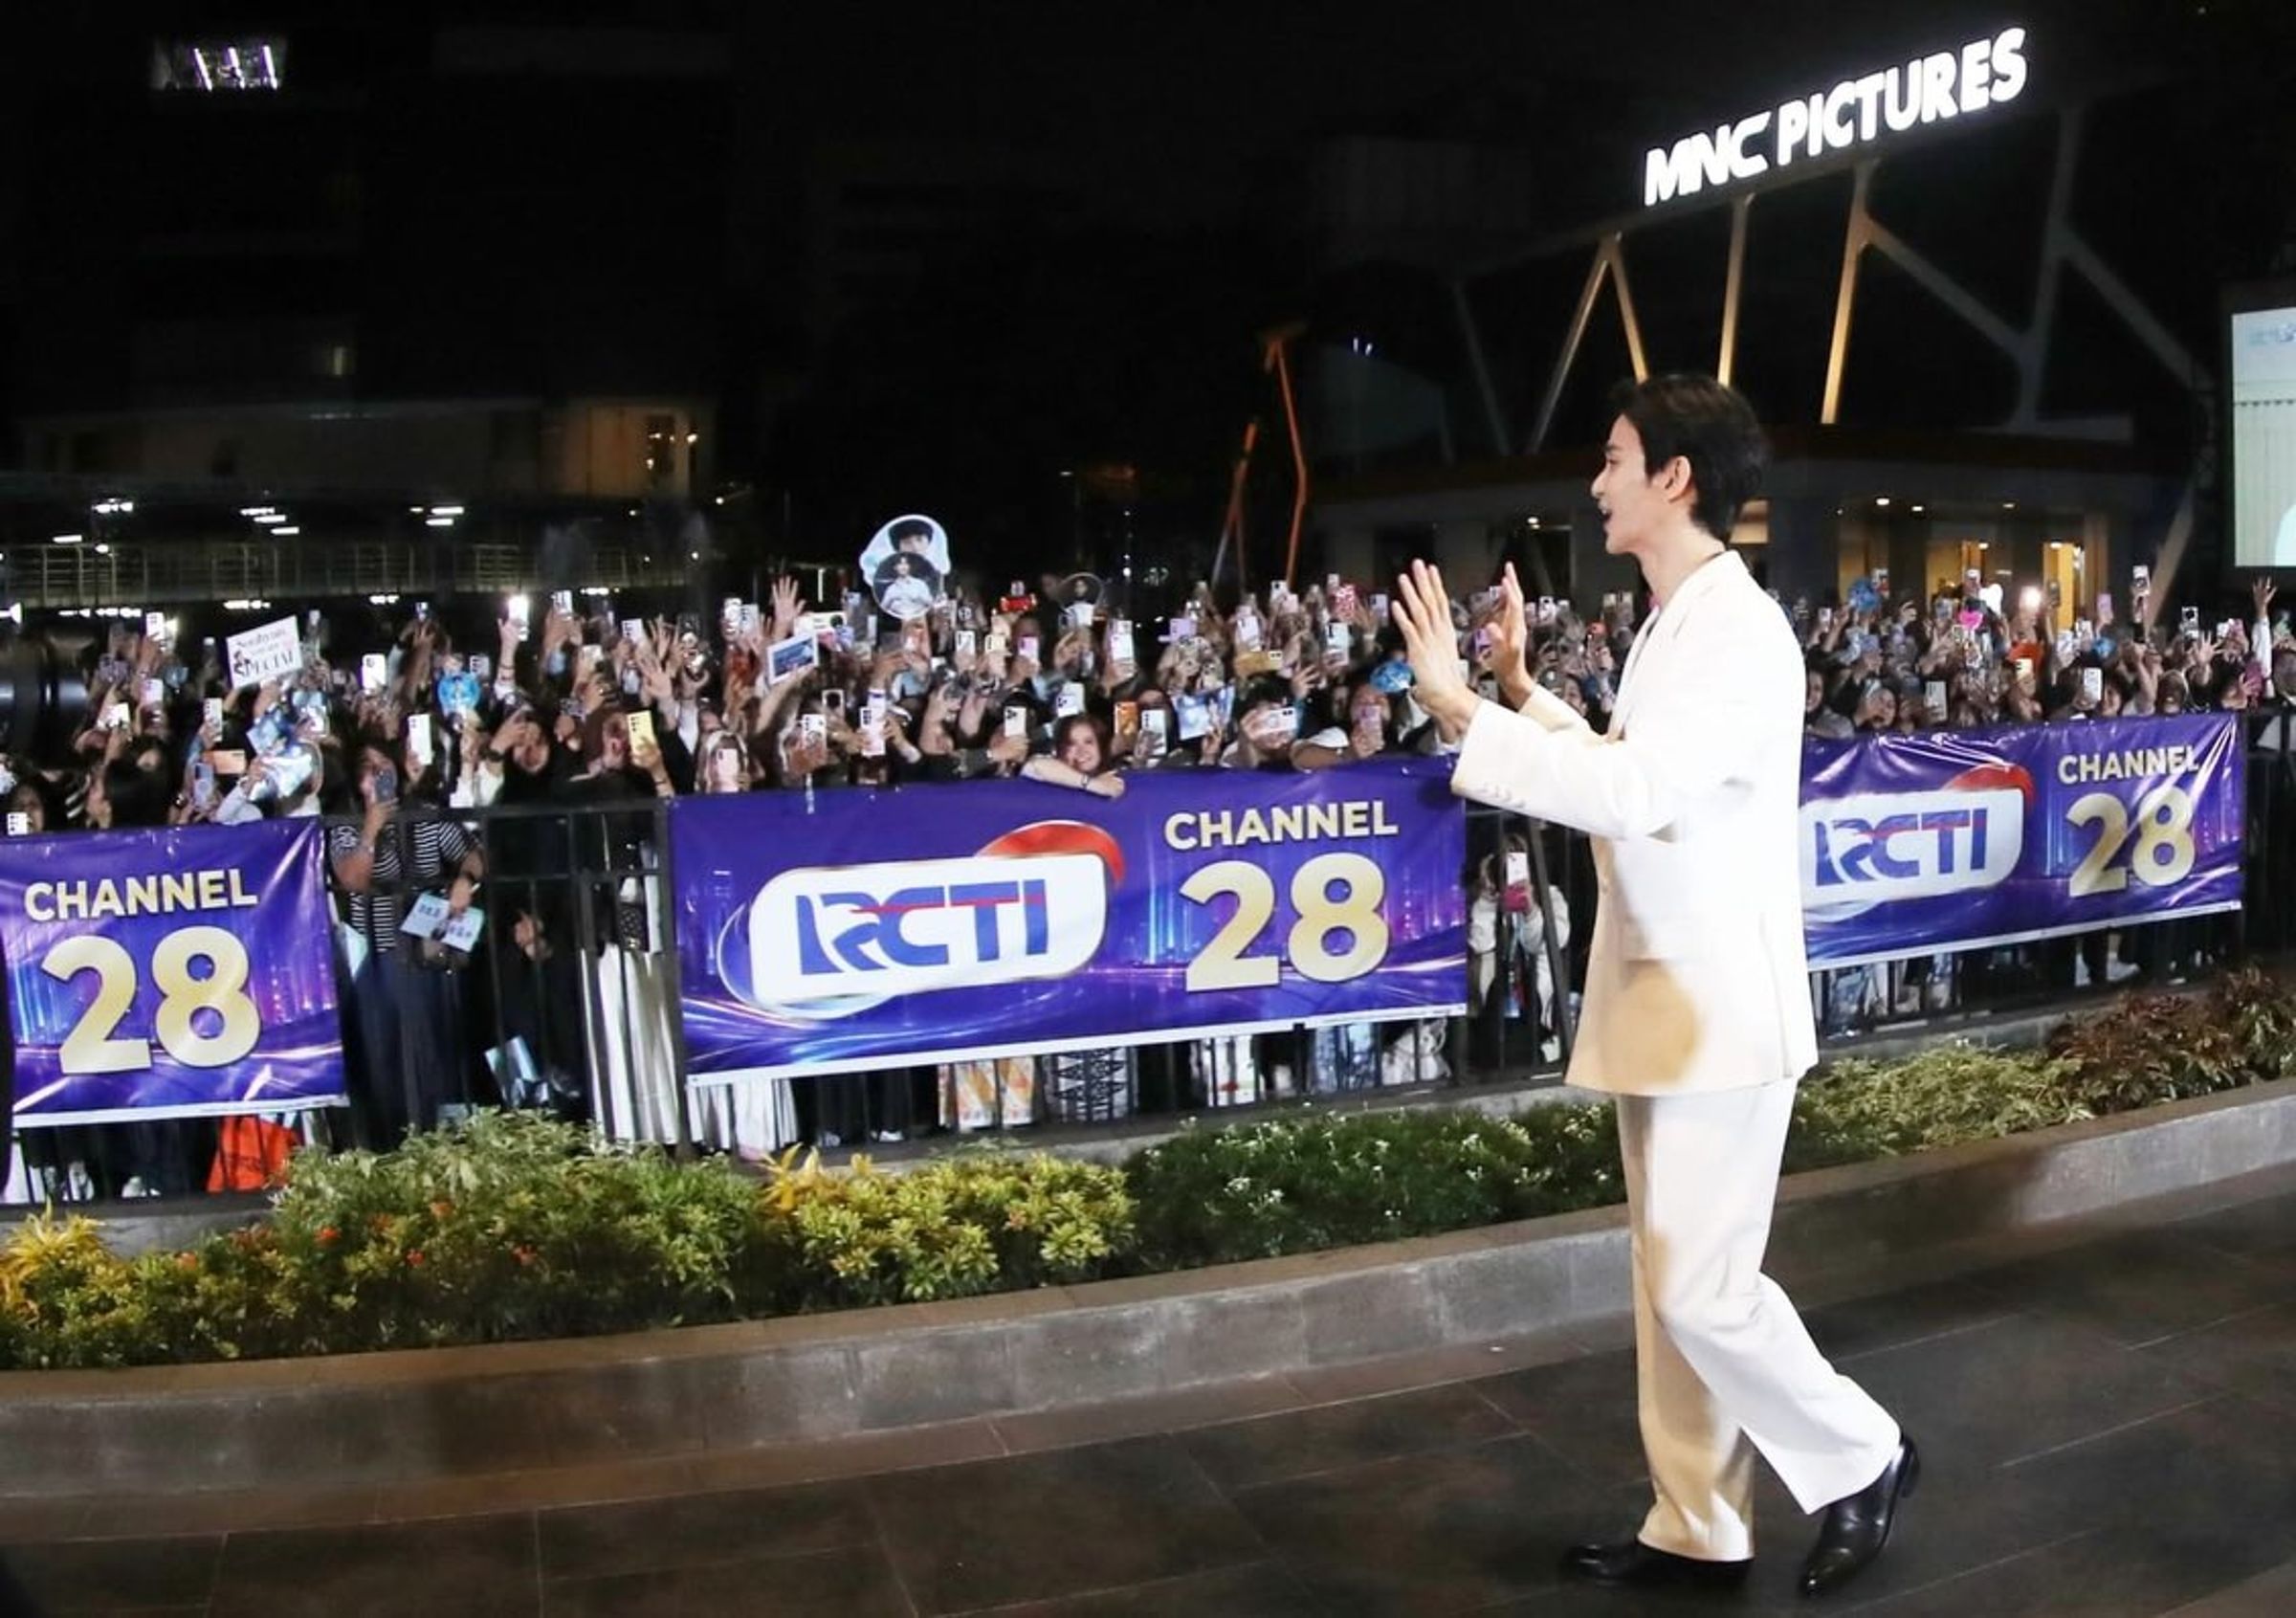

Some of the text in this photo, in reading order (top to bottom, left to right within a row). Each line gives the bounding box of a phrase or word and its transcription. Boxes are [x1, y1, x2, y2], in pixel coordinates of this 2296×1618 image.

[1645, 28, 2027, 207] MNC PICTURES
[2058, 745, 2200, 786] CHANNEL
[1163, 799, 1400, 851] CHANNEL
[1815, 808, 1989, 887] RCTI
[2066, 785, 2198, 898] 28
[23, 868, 259, 921] CHANNEL
[795, 877, 1049, 977] RCTI
[1179, 851, 1390, 994] 28
[40, 924, 262, 1075] 28
